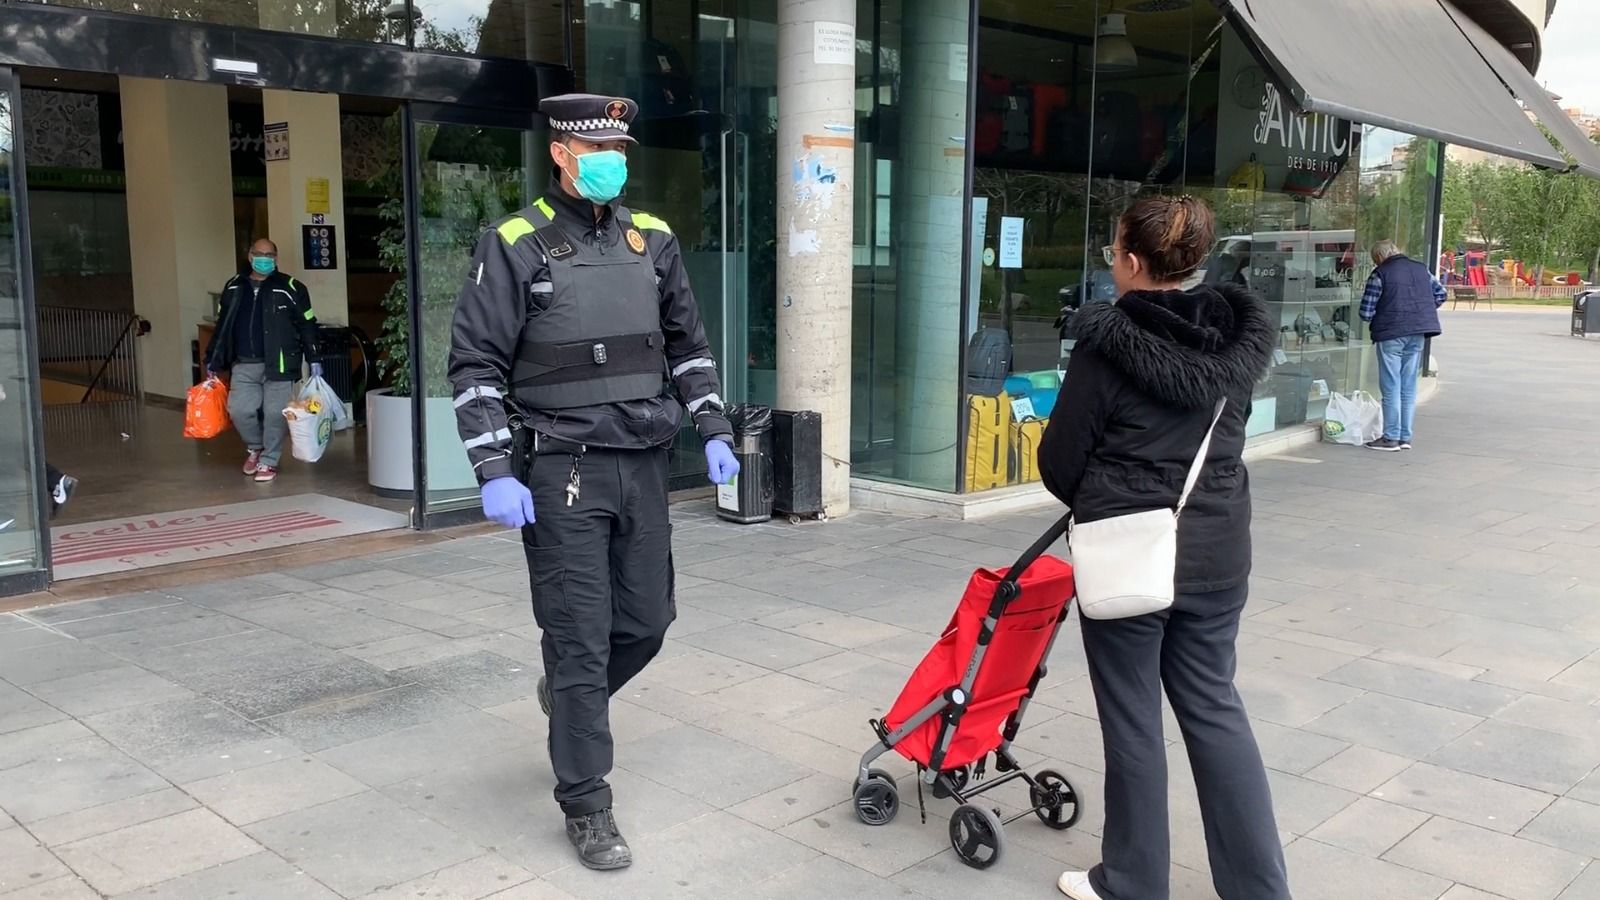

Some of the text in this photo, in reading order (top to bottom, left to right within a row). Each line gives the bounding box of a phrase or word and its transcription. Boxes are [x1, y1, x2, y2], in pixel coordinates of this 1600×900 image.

[1254, 82, 1273, 144] CASA
[1288, 156, 1338, 173] DES DE 1910
[59, 511, 229, 541] celler
